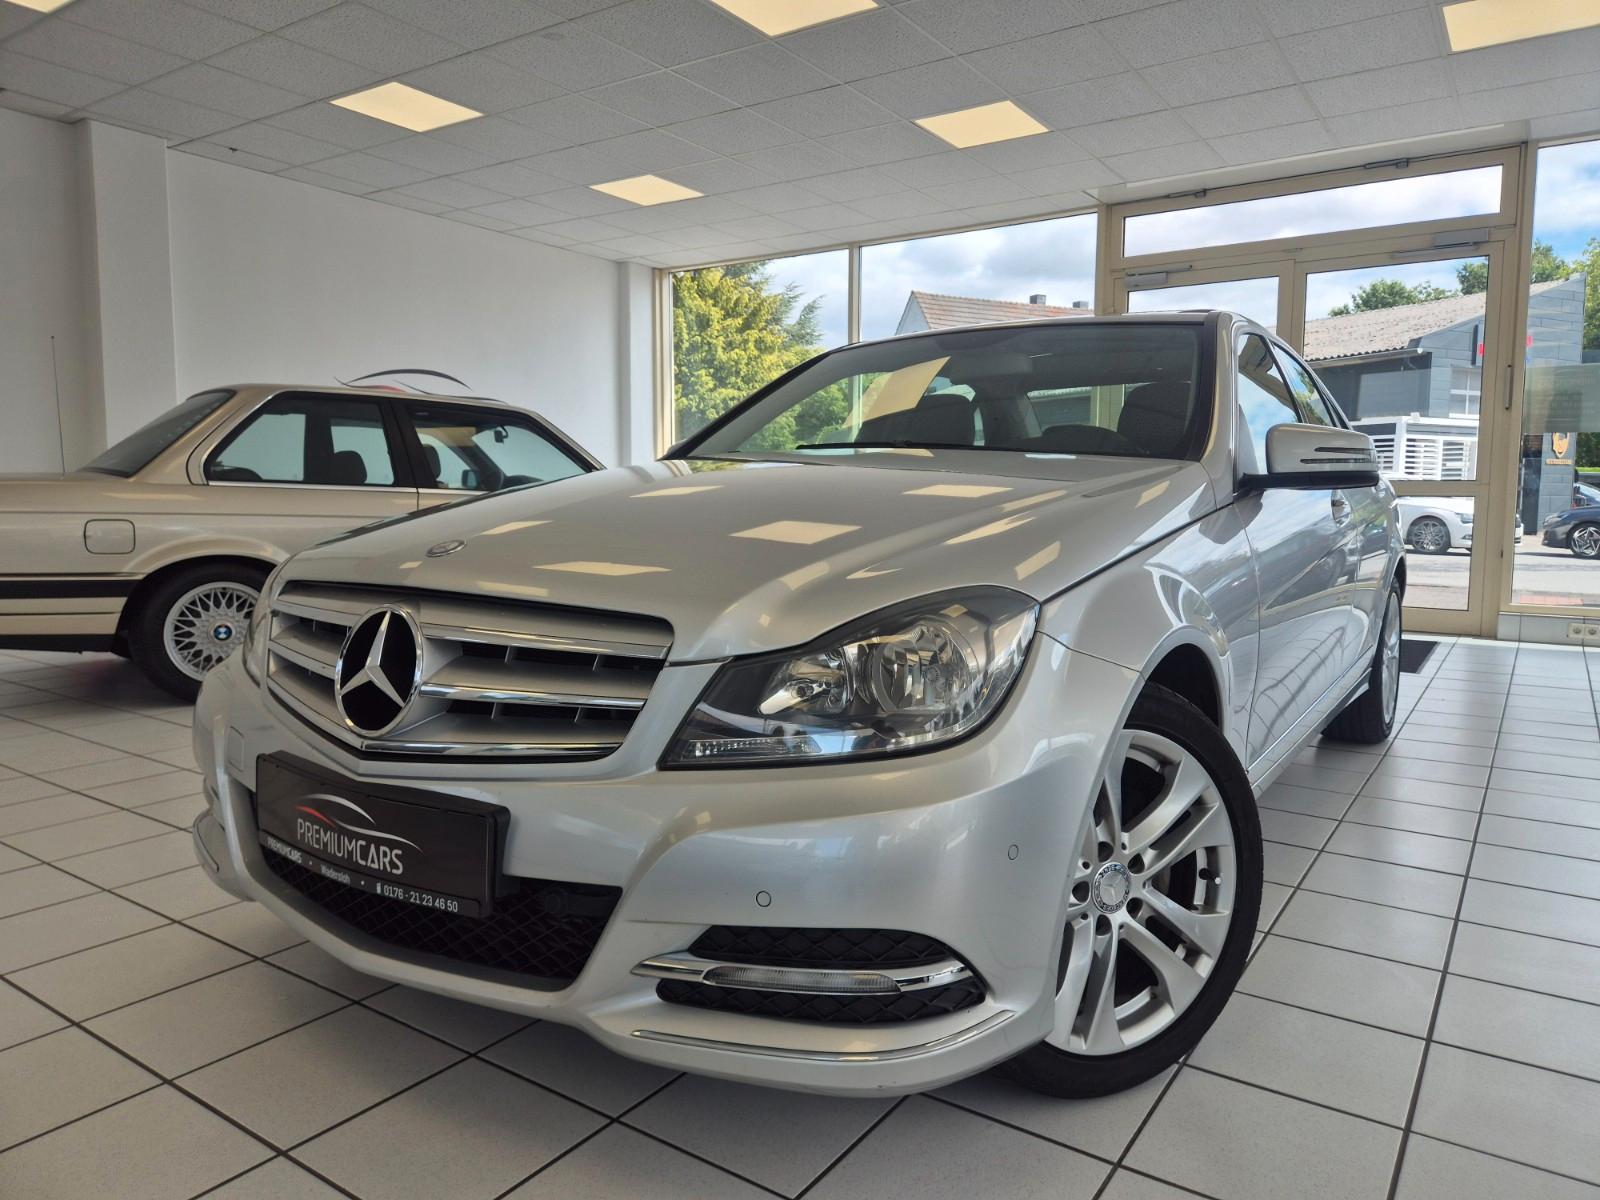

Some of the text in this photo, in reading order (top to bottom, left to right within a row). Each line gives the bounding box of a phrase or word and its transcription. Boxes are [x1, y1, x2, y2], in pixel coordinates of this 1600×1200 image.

[297, 818, 403, 875] PREMIUMCARS
[383, 885, 403, 900] 0176
[410, 891, 420, 904] 21
[422, 894, 433, 907] 23
[434, 897, 446, 910] 46
[447, 900, 459, 913] 50
